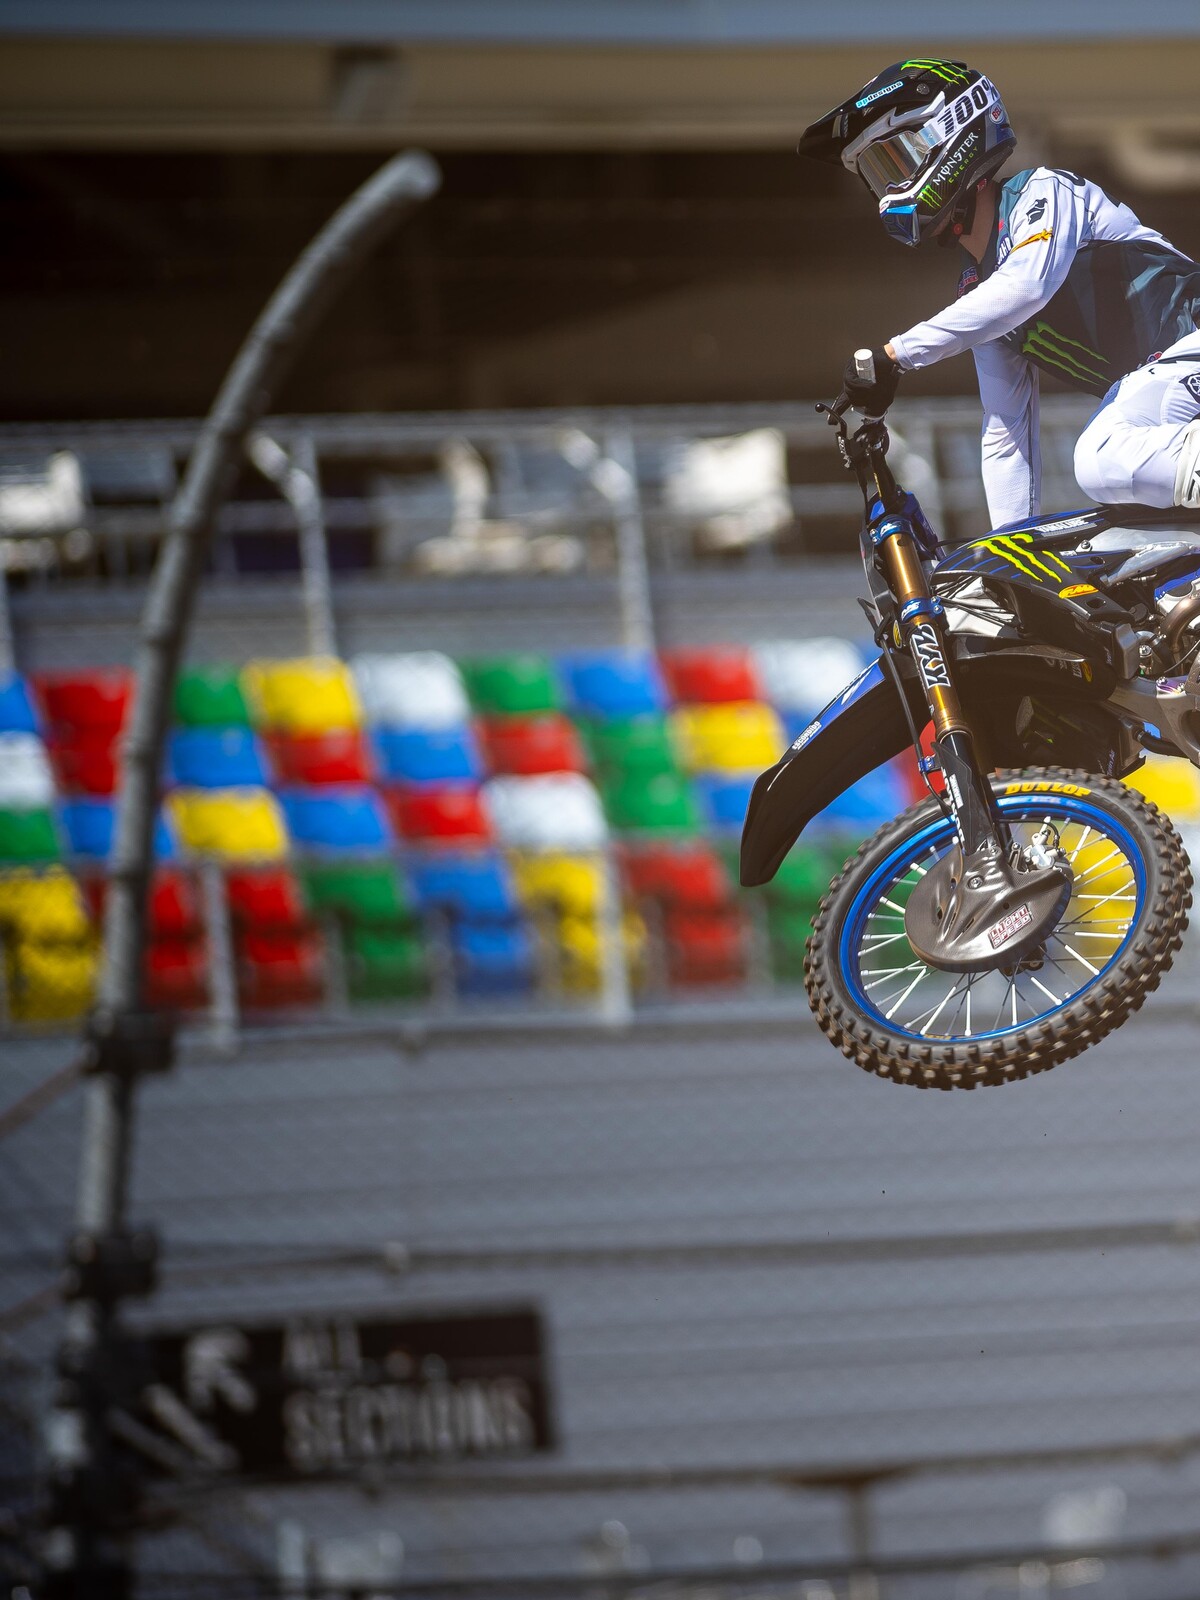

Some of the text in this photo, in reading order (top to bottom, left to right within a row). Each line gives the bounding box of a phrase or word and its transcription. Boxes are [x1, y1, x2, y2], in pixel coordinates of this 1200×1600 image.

[933, 132, 978, 185] MONSTER
[948, 146, 978, 183] ENERGY
[1004, 781, 1092, 797] DUNLOP
[990, 907, 1028, 939] LIGHT
[993, 915, 1030, 948] SPEED
[285, 1377, 534, 1472] SECTIONS
